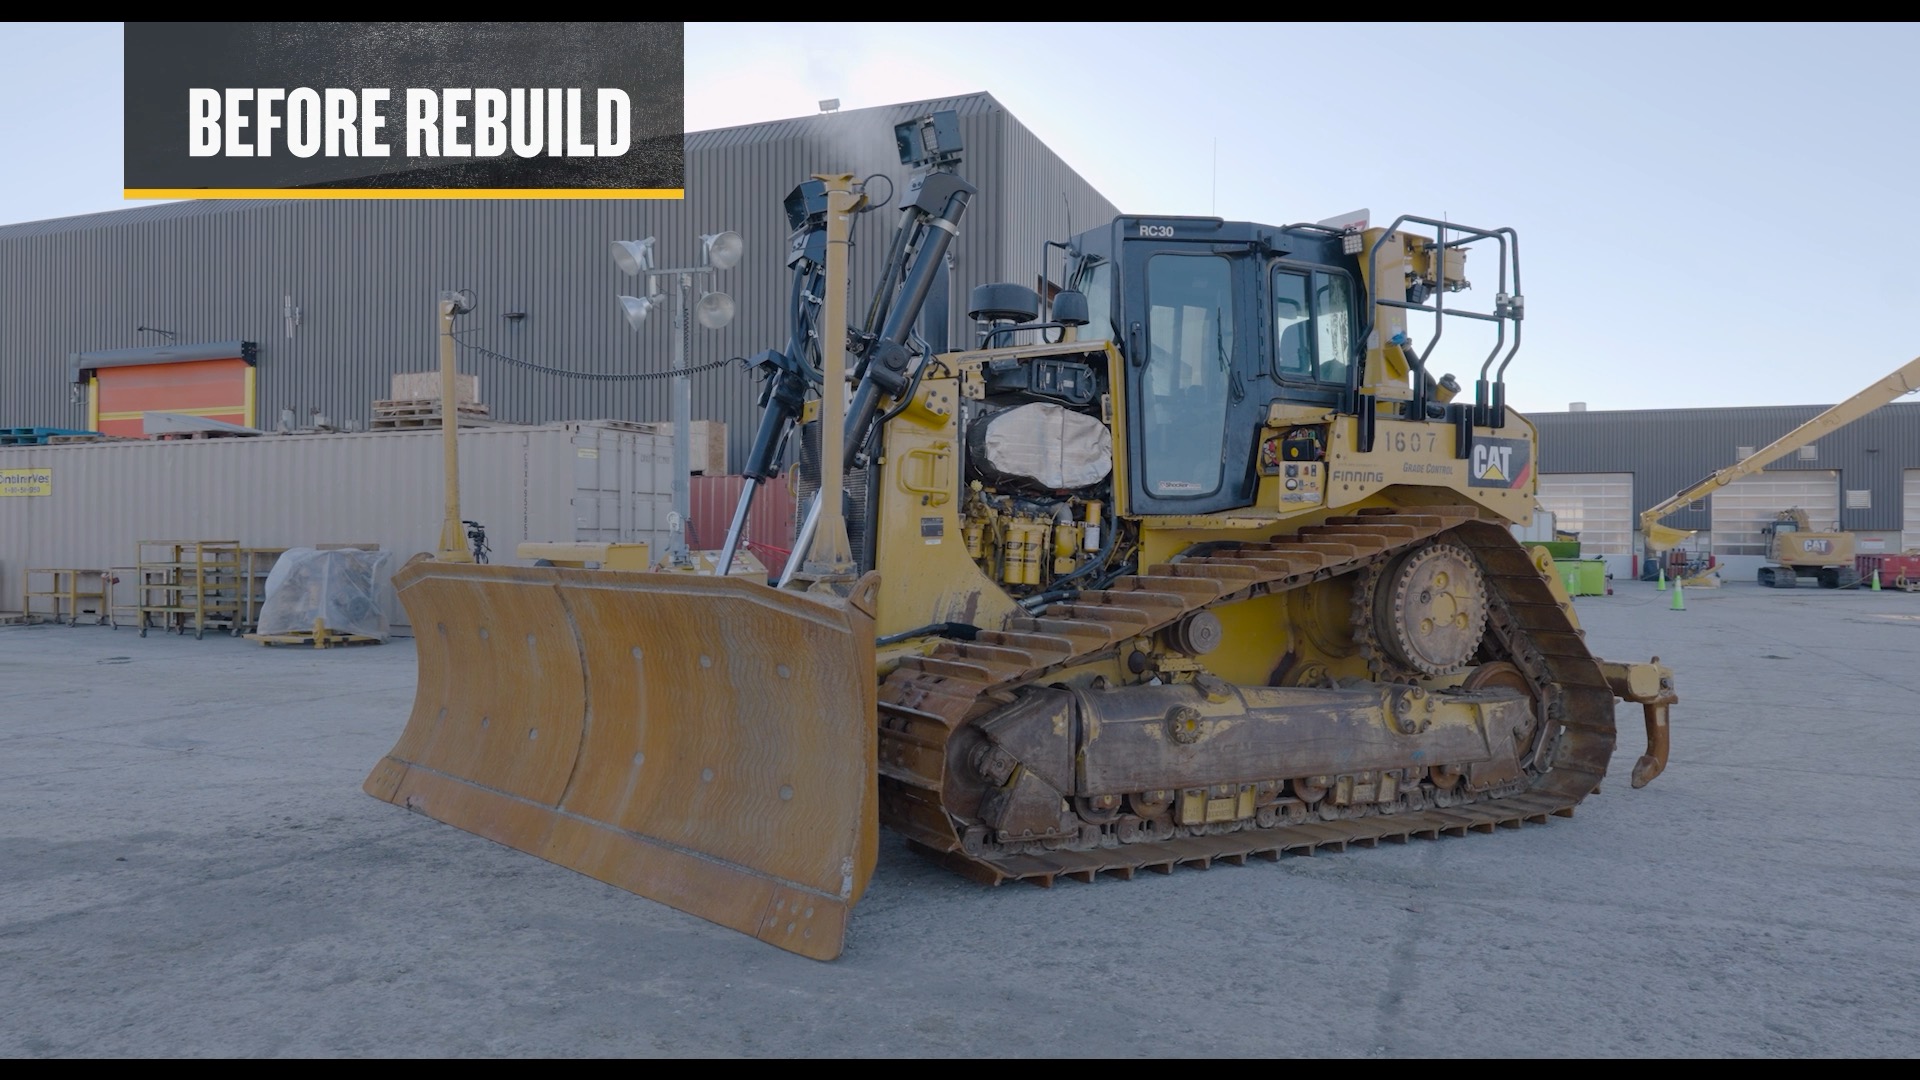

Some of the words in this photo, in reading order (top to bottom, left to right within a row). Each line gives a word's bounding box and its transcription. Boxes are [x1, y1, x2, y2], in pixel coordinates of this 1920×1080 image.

[1140, 225, 1174, 237] RC30
[1385, 431, 1436, 452] 1607
[1403, 462, 1424, 473] GRADE
[1426, 463, 1453, 475] CONTROL
[1473, 444, 1512, 481] CAT
[1333, 471, 1384, 482] FINNING
[1804, 540, 1827, 552] CAT
